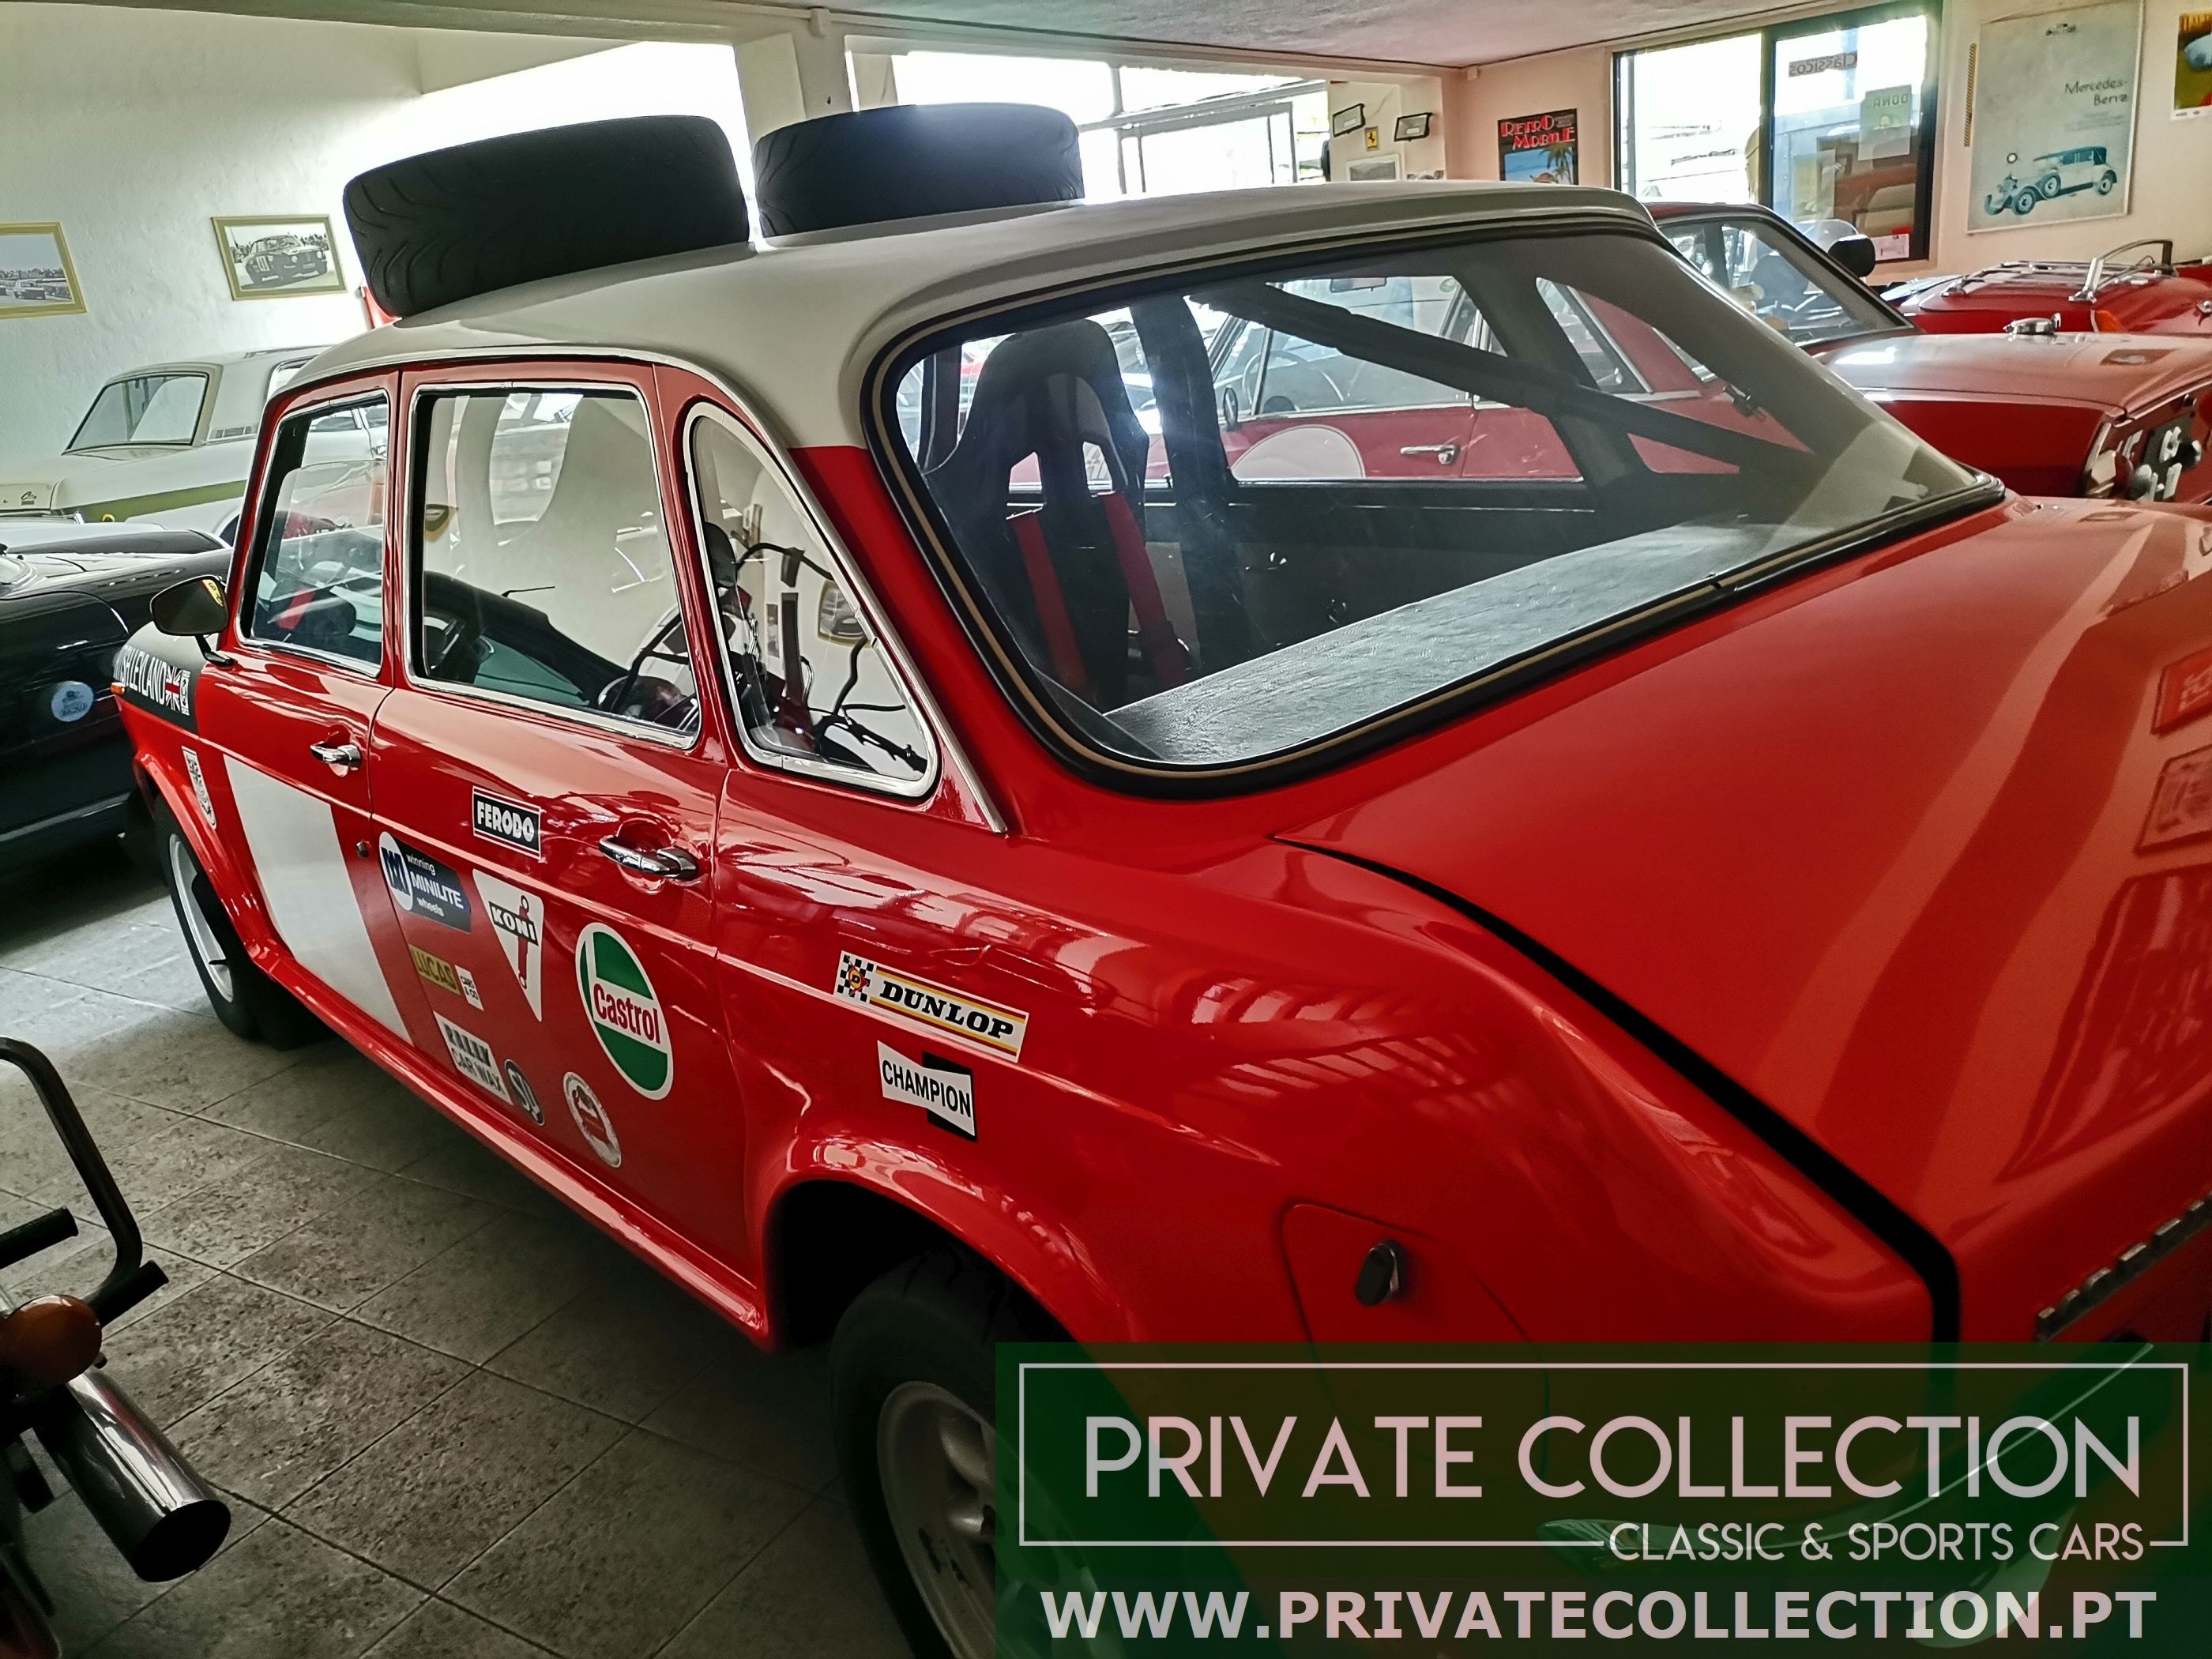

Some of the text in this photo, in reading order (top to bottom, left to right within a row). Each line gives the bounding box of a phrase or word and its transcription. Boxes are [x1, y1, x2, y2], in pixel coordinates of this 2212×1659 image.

[2094, 94, 2127, 107] Benz
[1501, 115, 1554, 137] RETRO
[1512, 126, 1575, 150] MOBILE
[477, 800, 535, 842] FERODO
[405, 854, 436, 876] winning
[409, 871, 465, 910] MINILITE
[491, 905, 536, 941] KONI
[412, 948, 457, 991] LUCAS
[593, 983, 661, 1044] Castrol
[879, 980, 1014, 1040] DUNLOP
[882, 1059, 972, 1119] CHAMPION
